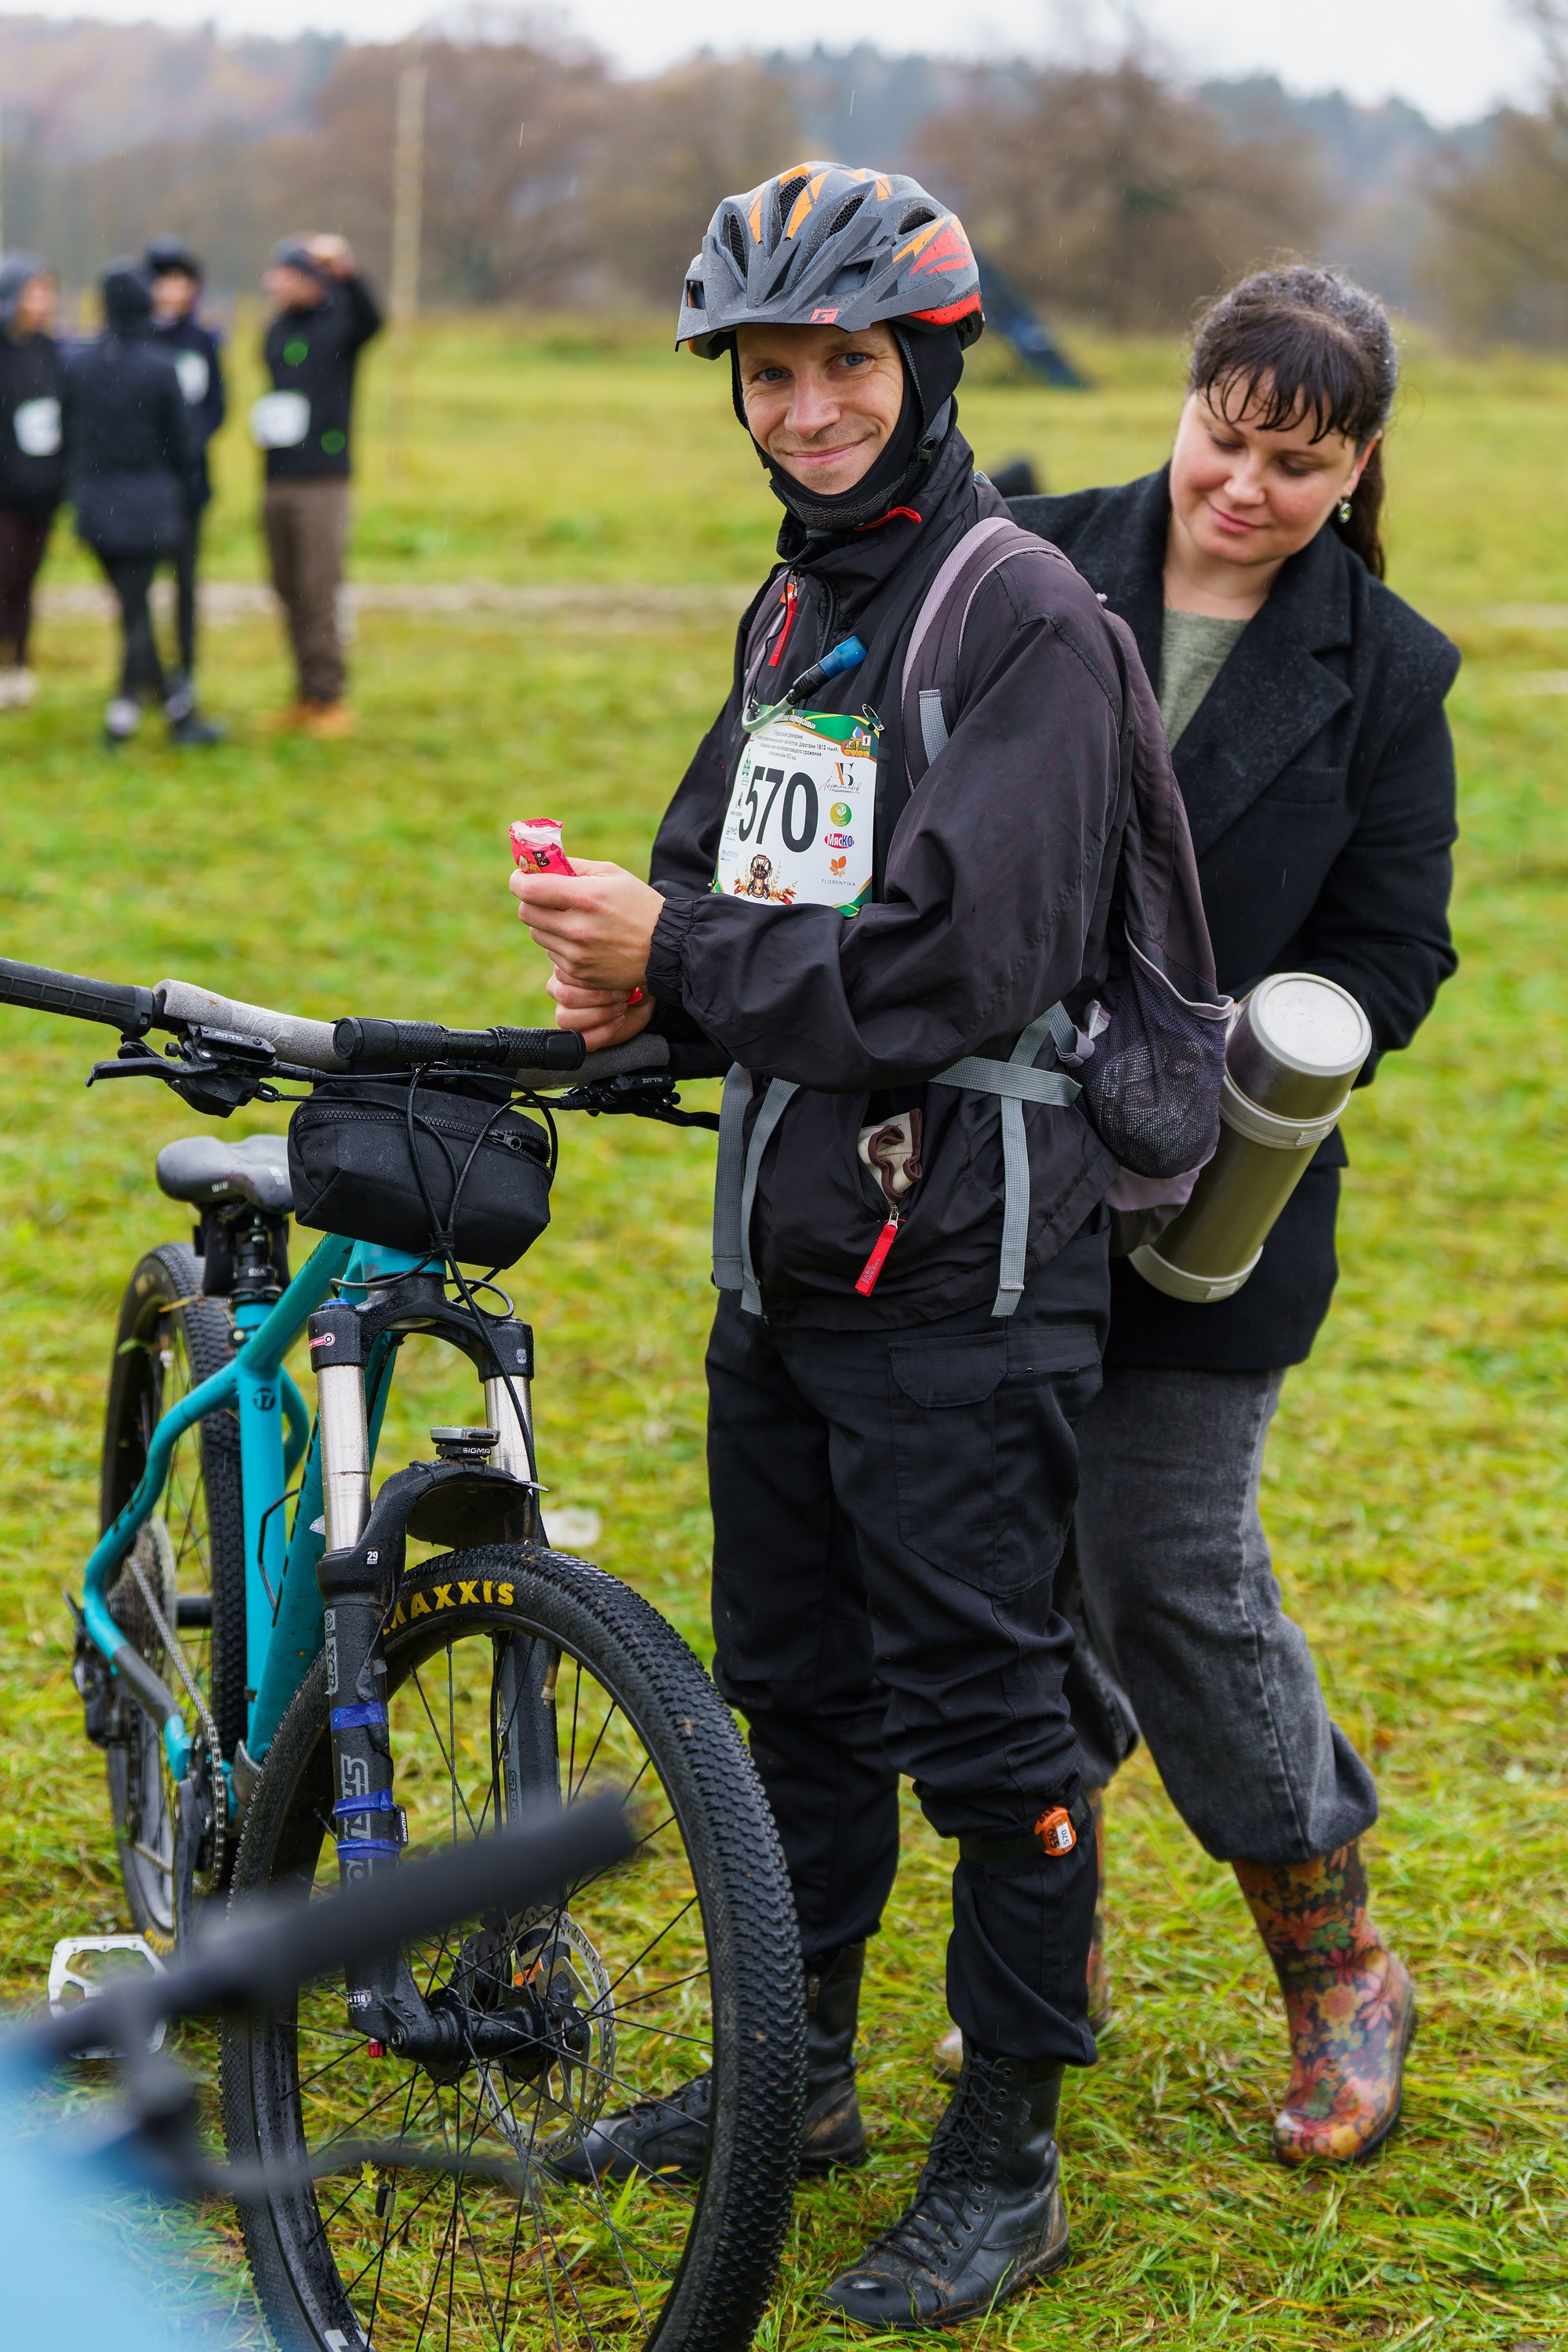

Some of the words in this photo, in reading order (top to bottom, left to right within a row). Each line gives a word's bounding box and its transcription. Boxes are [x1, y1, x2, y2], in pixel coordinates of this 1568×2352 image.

[739, 765, 818, 853] 570
[821, 878, 856, 887] FLORENTIKA
[367, 1551, 379, 1561] 29
[1061, 1829, 1070, 1846] 570
